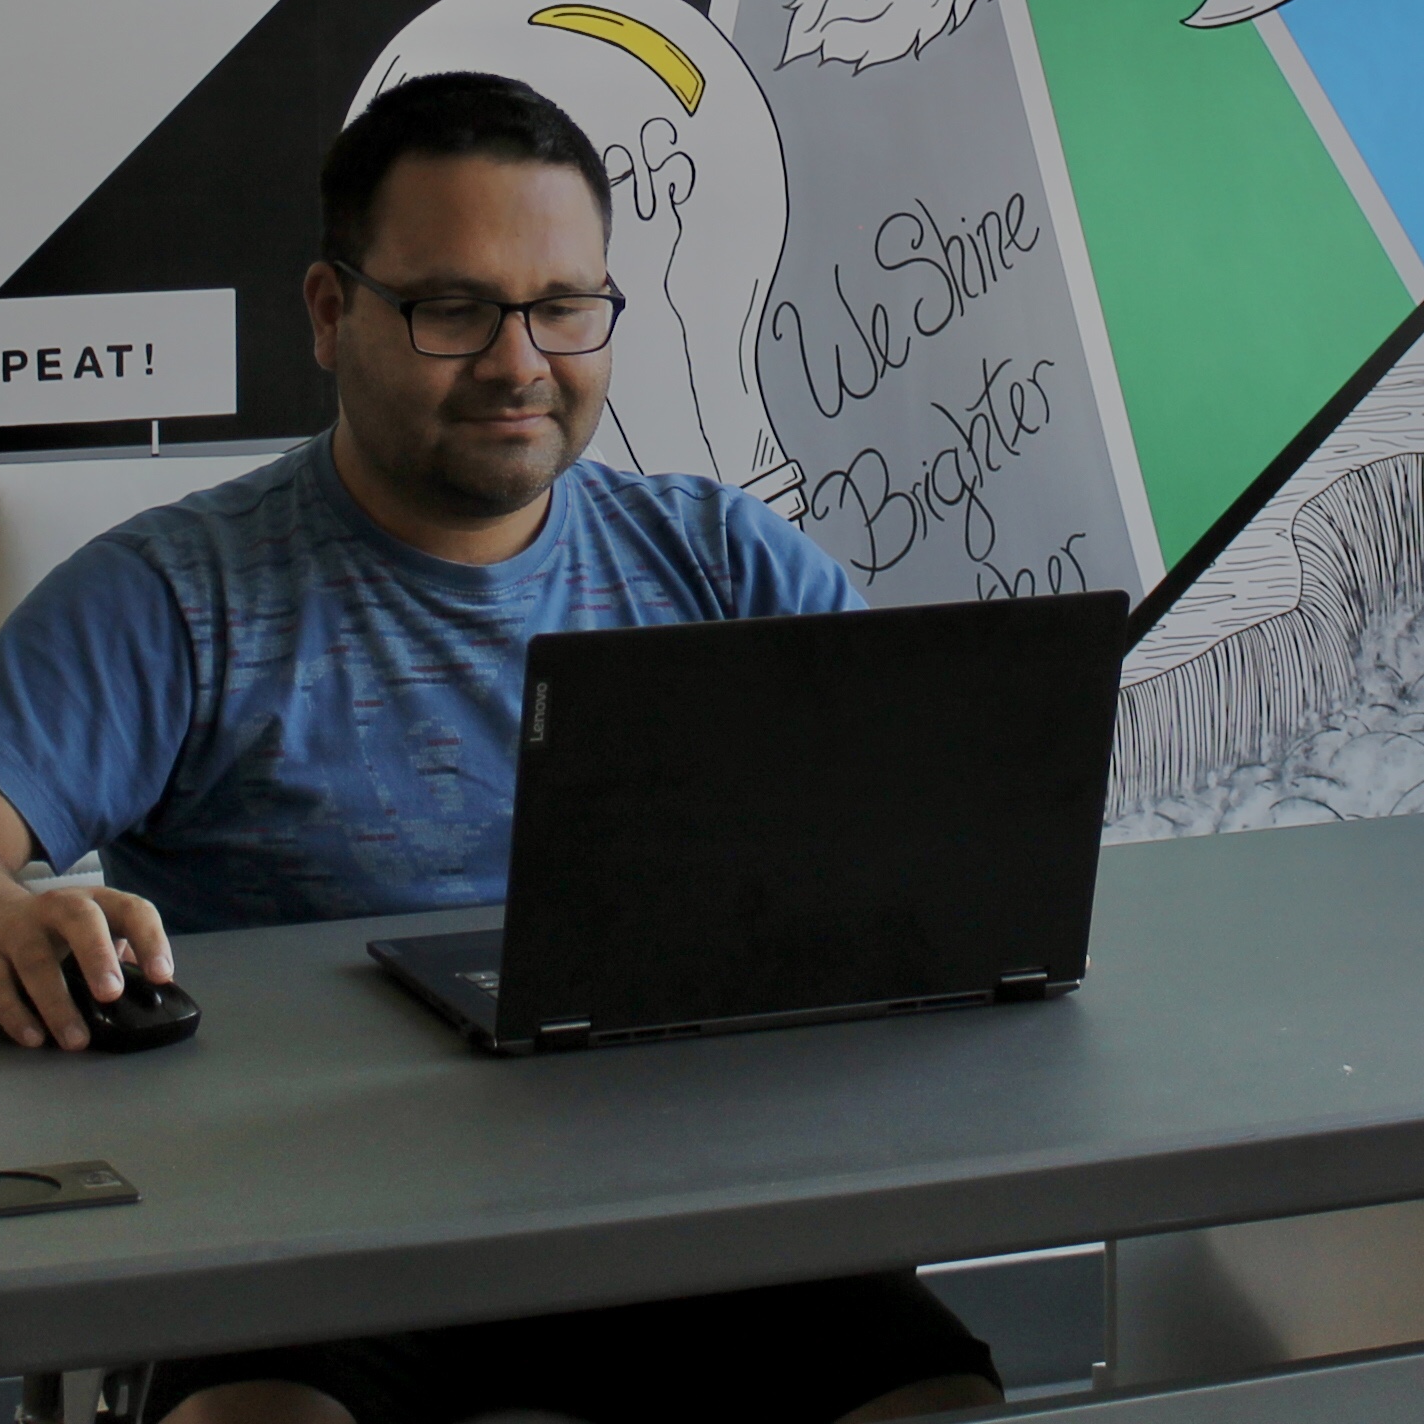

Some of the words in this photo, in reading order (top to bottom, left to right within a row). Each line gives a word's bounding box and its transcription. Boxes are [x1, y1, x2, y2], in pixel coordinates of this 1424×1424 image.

[772, 263, 911, 418] We
[874, 192, 1040, 337] Shine
[811, 357, 1055, 587] Brighter
[530, 682, 548, 742] Lenovo
